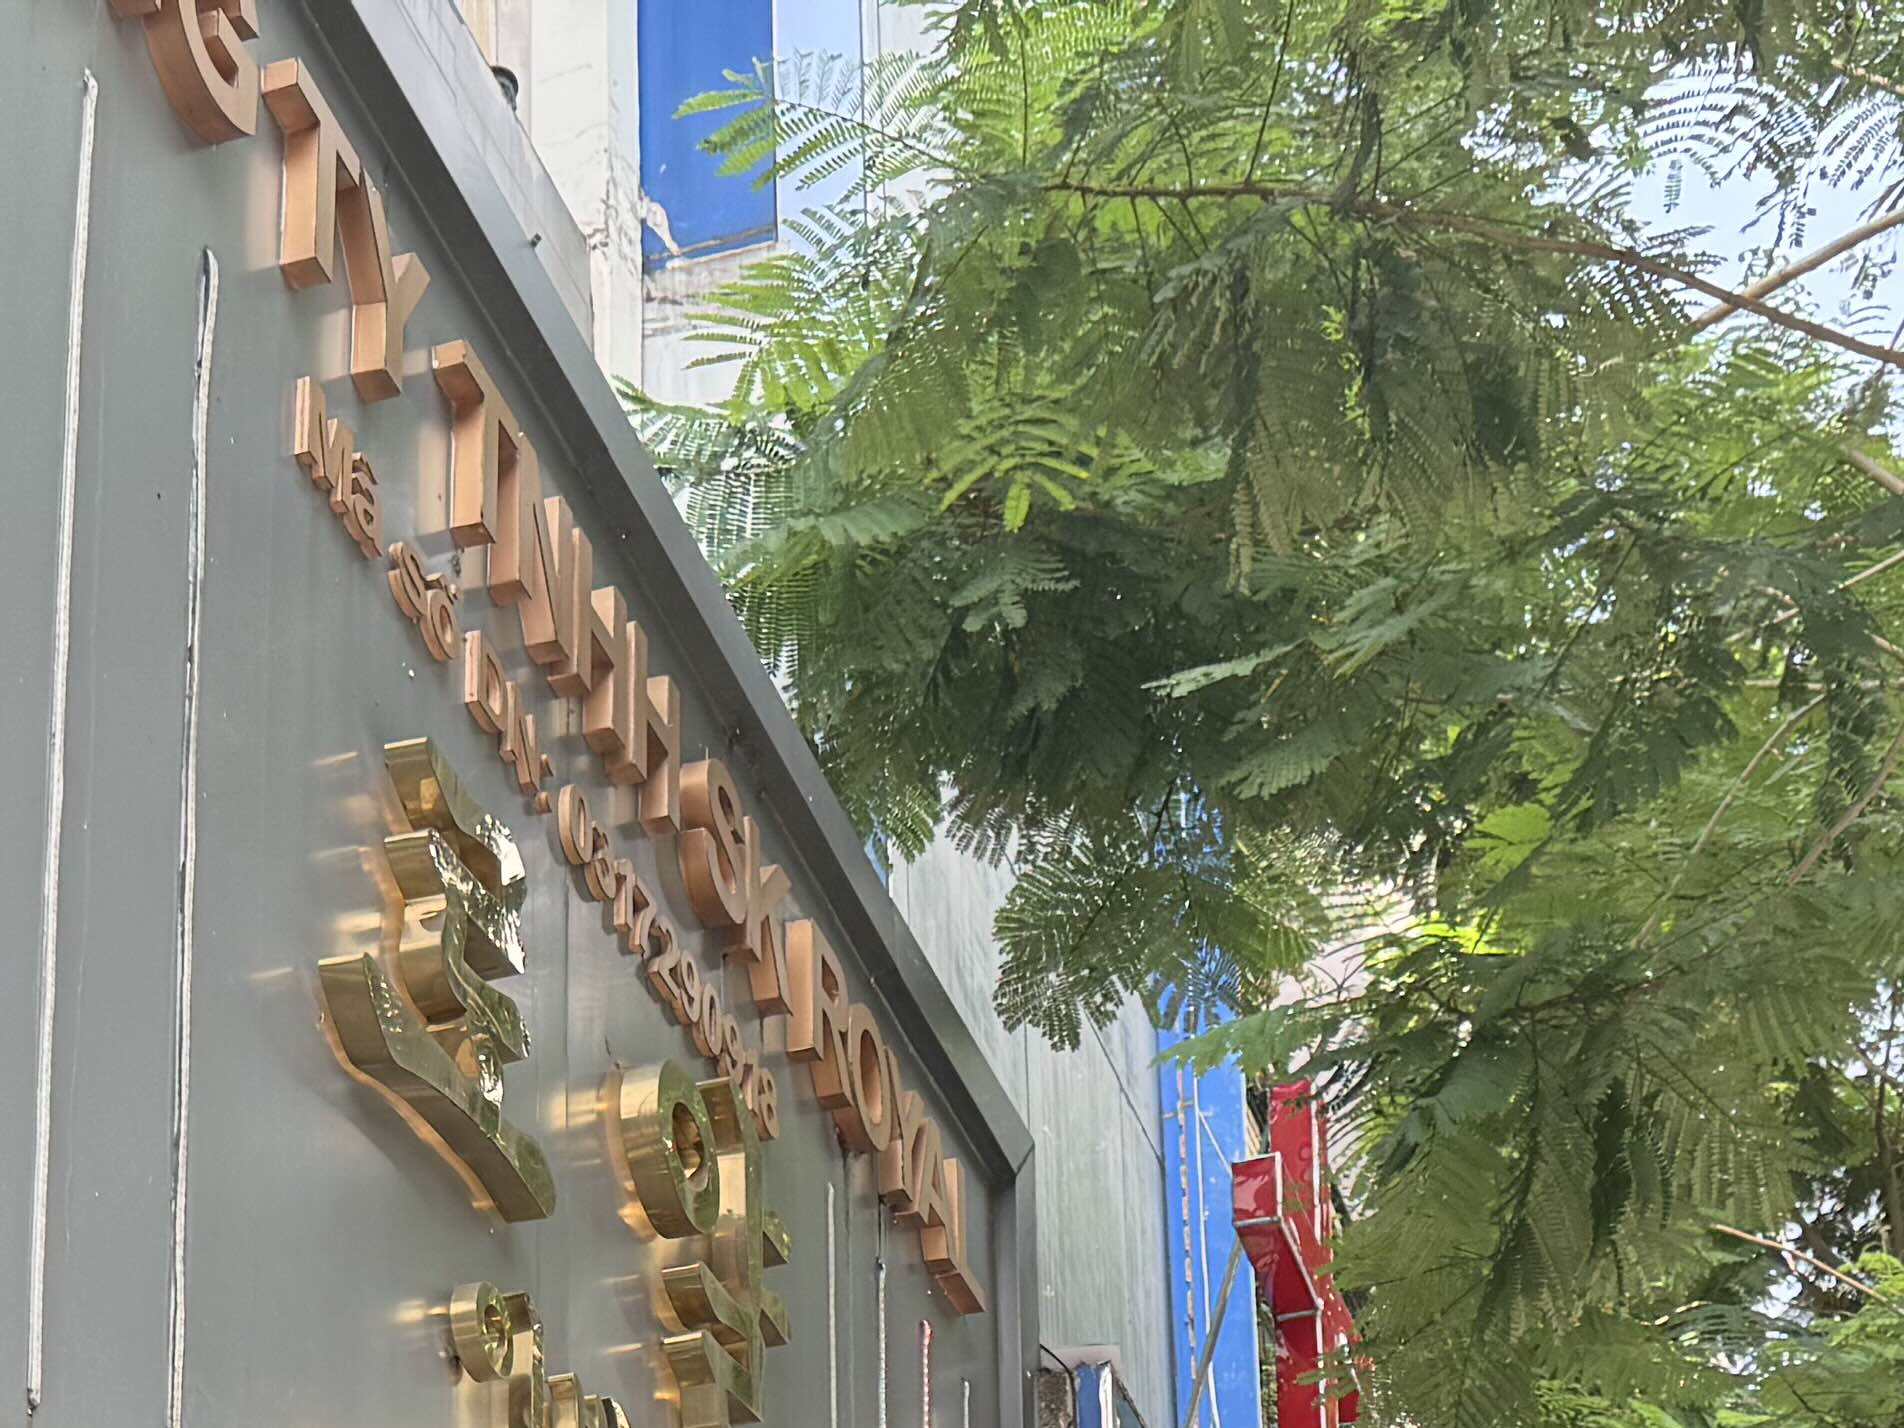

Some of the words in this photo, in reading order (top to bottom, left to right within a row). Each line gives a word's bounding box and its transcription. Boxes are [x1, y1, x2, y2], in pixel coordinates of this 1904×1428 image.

[261, 57, 431, 402] TY
[433, 339, 681, 838] TNHH
[679, 757, 794, 1018] SK
[784, 918, 988, 1316] ROYAL
